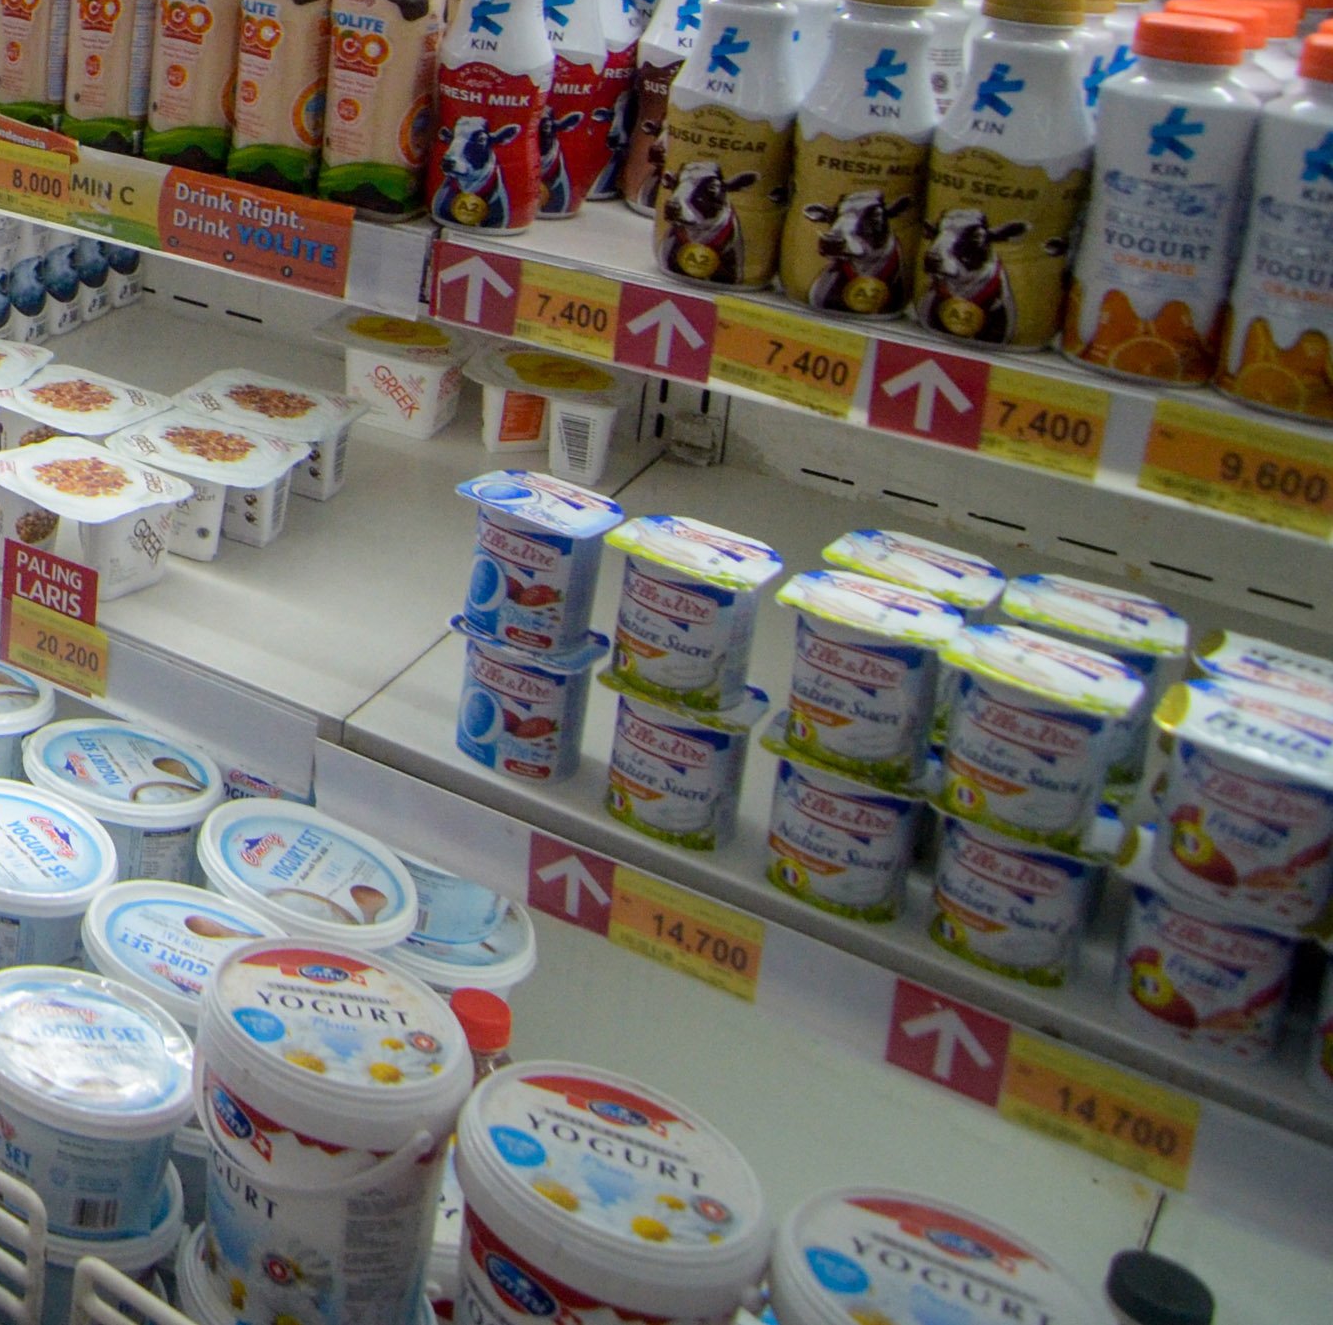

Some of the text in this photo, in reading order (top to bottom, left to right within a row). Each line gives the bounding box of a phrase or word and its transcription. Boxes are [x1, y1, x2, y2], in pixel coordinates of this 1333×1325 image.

[471, 37, 498, 52] KIN
[488, 93, 531, 108] MILK
[553, 82, 593, 95] MILK
[706, 79, 734, 94] KIN
[868, 104, 901, 119] KIN
[970, 119, 1005, 136] KIN
[706, 135, 767, 154] SEGAR
[12, 168, 63, 199] 8,000
[817, 155, 883, 175] FRESH
[175, 183, 307, 232] Drink Right.
[970, 181, 1039, 201] SEGAR
[173, 209, 338, 268] Drink YOLITE
[1104, 228, 1212, 261] YOGURT
[536, 293, 609, 333] 7,400
[765, 340, 851, 387] 7,400
[375, 364, 420, 420] GREEK
[997, 400, 1094, 449] 7,400
[16, 549, 82, 590] PALING
[15, 572, 82, 618] LARIS
[36, 630, 99, 672] 20,200
[6, 820, 58, 874] YOGURT
[256, 990, 410, 1028] YOGURT
[526, 1112, 706, 1188] YOGURT
